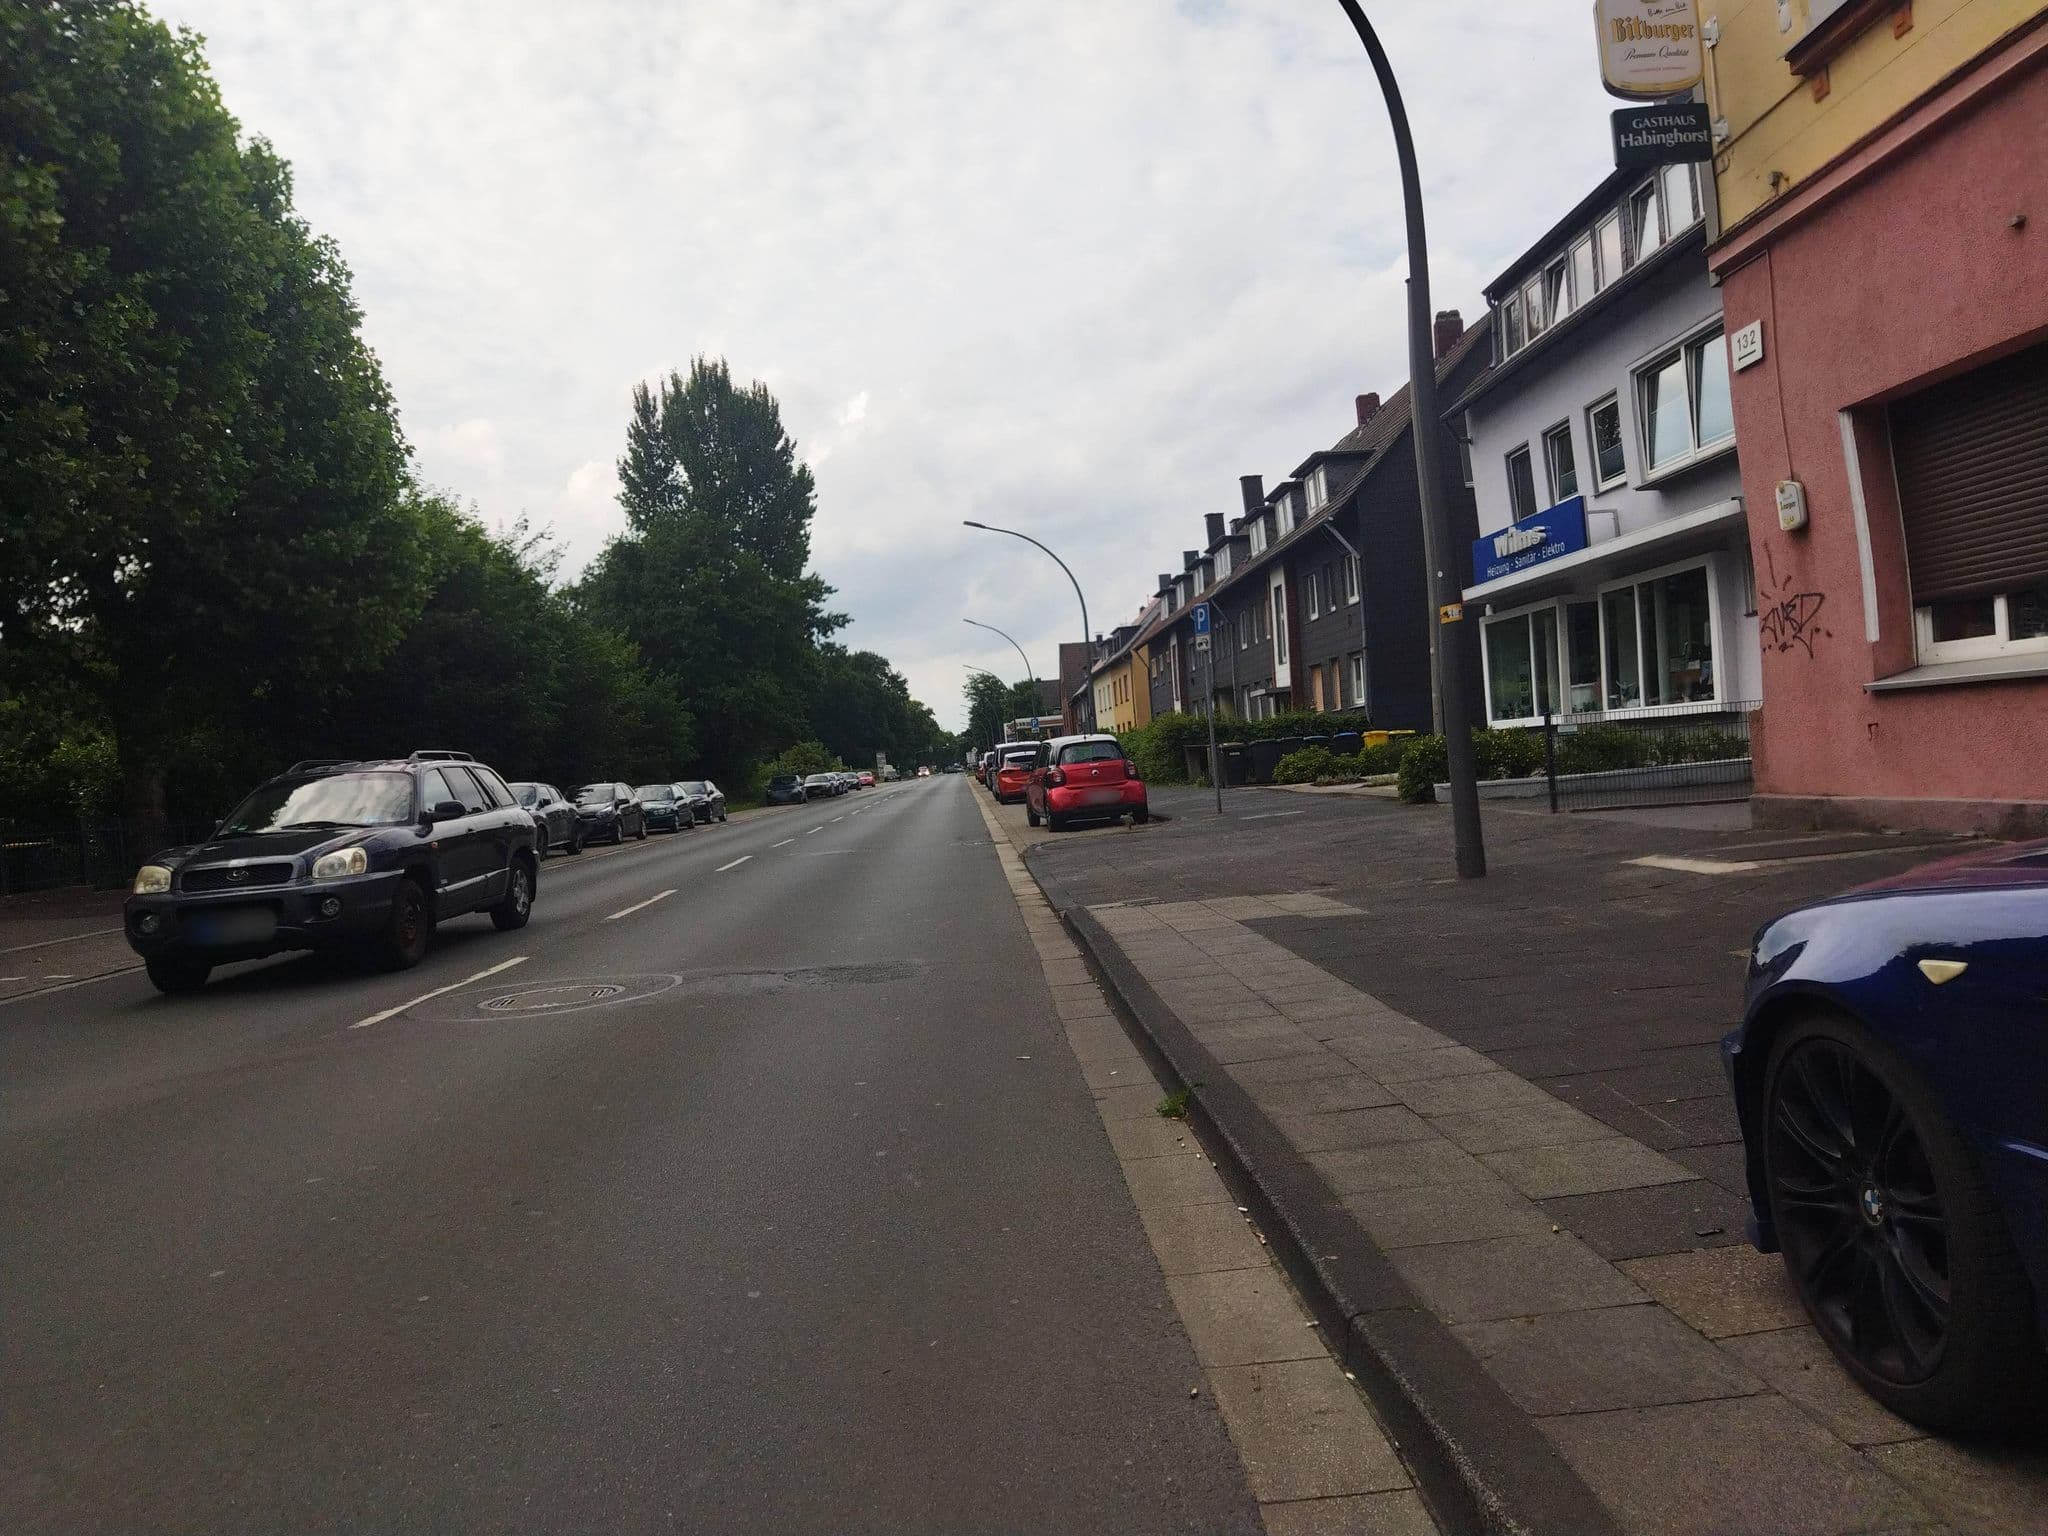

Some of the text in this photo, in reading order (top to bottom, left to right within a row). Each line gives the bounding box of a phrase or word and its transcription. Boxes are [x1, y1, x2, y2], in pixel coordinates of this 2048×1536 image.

[1611, 16, 1695, 42] Bitburger
[1632, 115, 1696, 128] GASTHAUS
[1620, 128, 1709, 148] Habinghorst
[1736, 329, 1756, 352] 132
[1486, 561, 1510, 577] Heizung
[1542, 541, 1566, 559] Elektro
[1198, 608, 1206, 630] P
